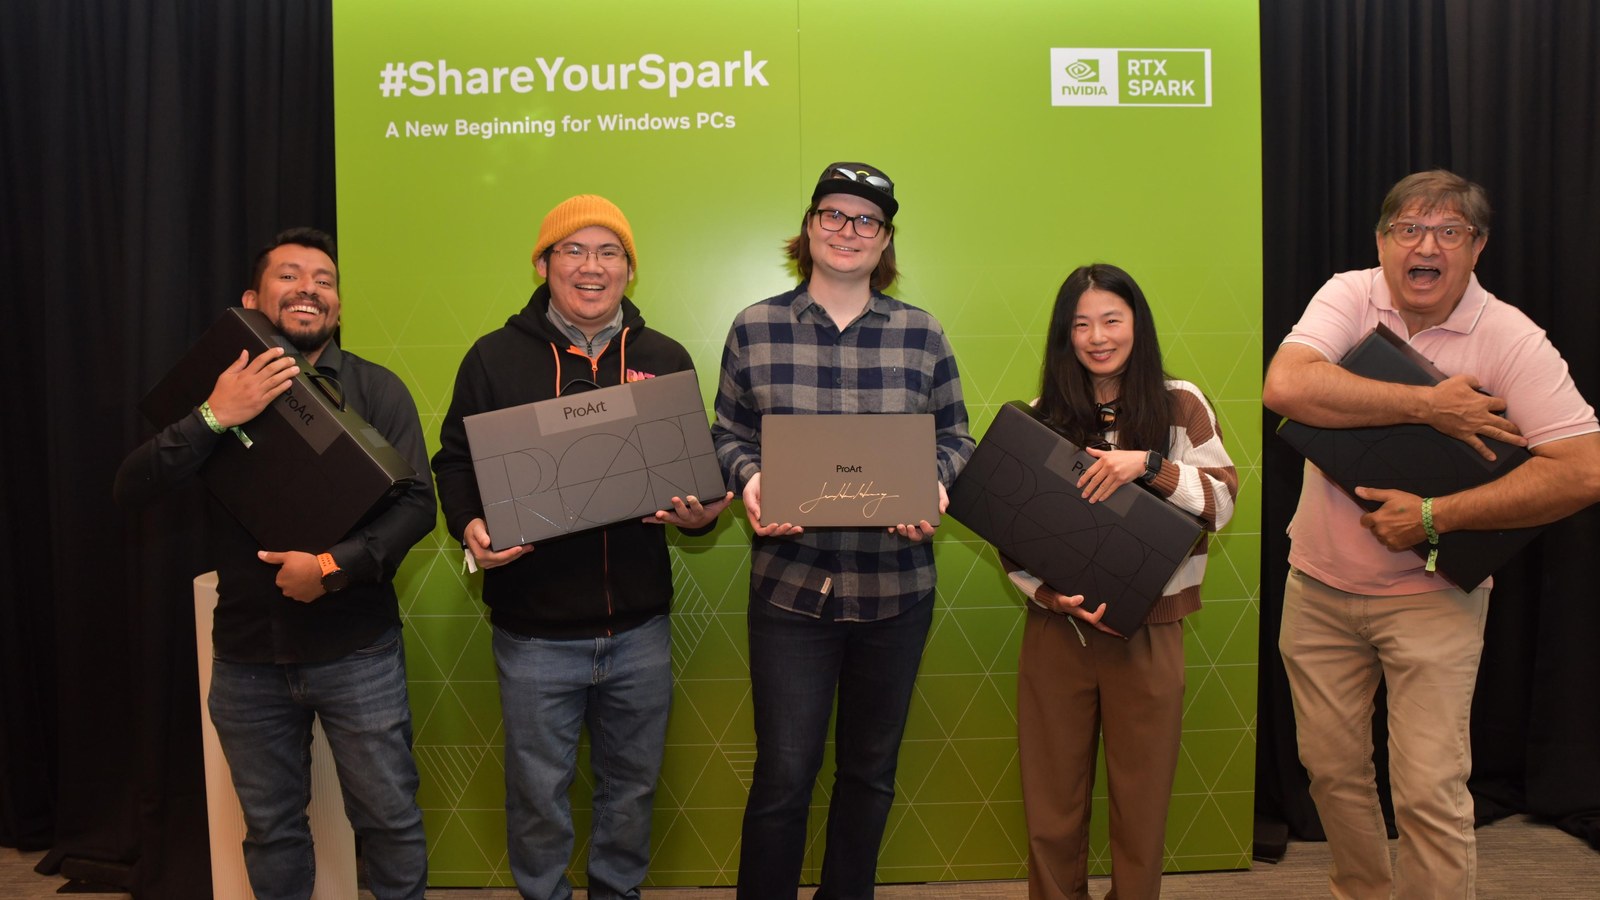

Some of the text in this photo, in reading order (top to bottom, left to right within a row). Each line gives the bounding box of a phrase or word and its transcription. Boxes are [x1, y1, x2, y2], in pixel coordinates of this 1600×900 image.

[379, 50, 770, 98] #ShareYourSpark
[1127, 59, 1167, 76] RTX
[1127, 79, 1195, 96] SPARK
[385, 111, 736, 140] A New Beginning for Windows PCs
[563, 401, 607, 420] ProArt
[836, 465, 862, 473] ProArt
